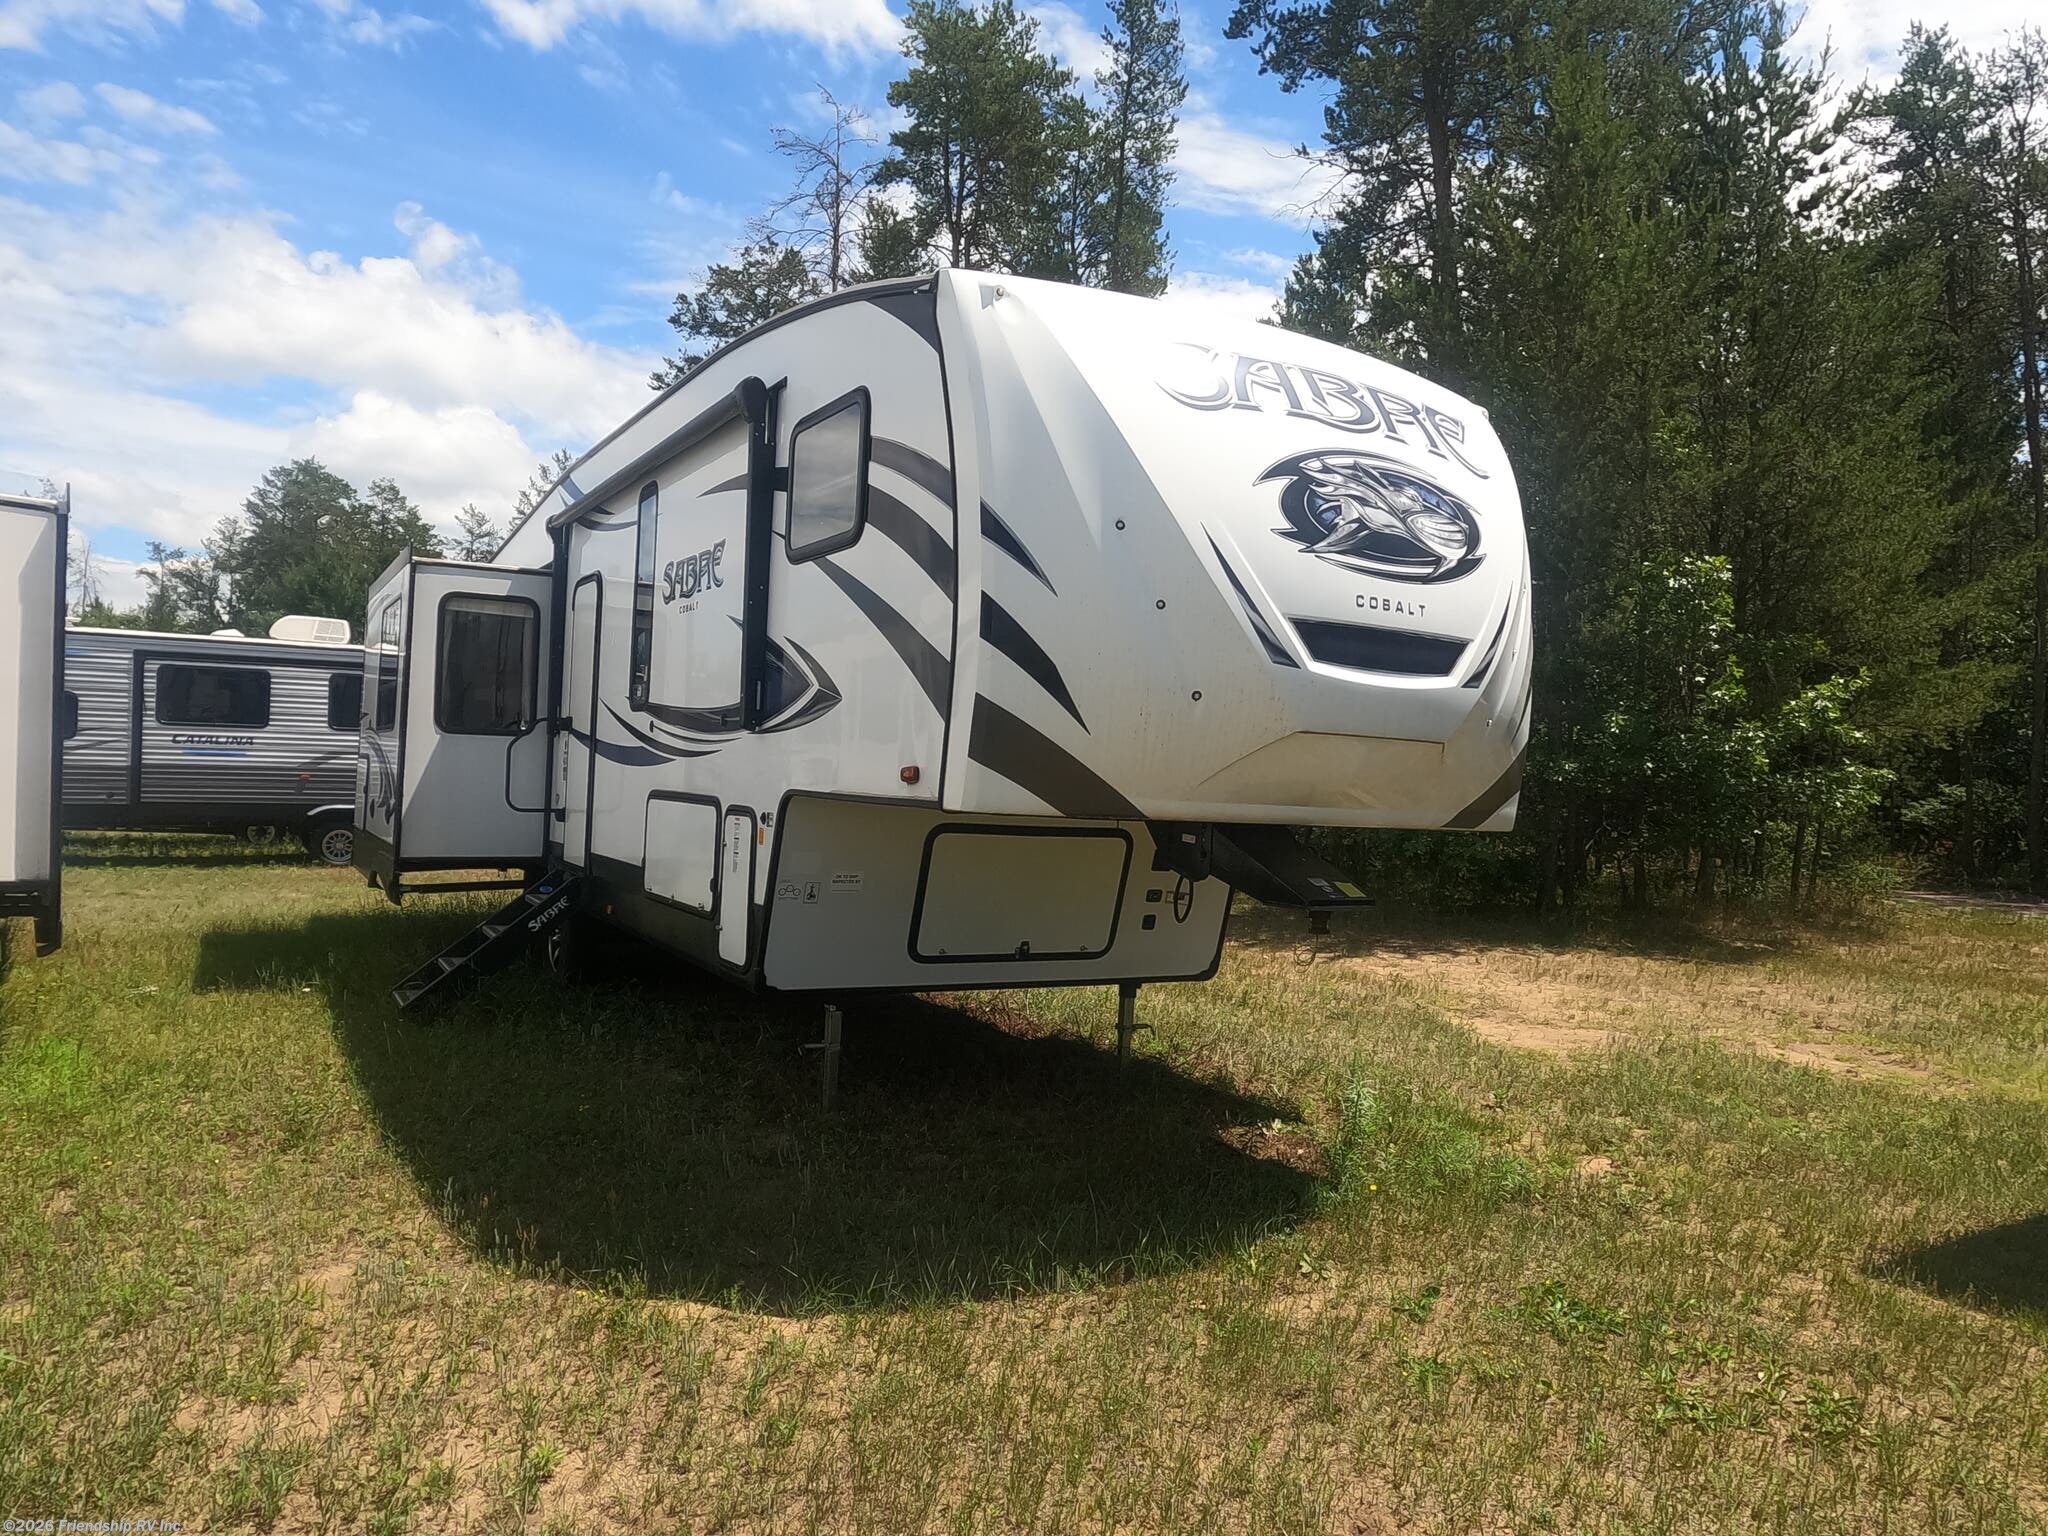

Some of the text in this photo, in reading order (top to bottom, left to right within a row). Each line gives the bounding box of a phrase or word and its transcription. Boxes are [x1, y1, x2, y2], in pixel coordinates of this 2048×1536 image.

[662, 538, 726, 605] SABRE
[679, 600, 699, 615] COBALT
[1355, 594, 1426, 617] COBALT
[172, 734, 255, 746] CATALINA
[527, 895, 570, 932] SABRE
